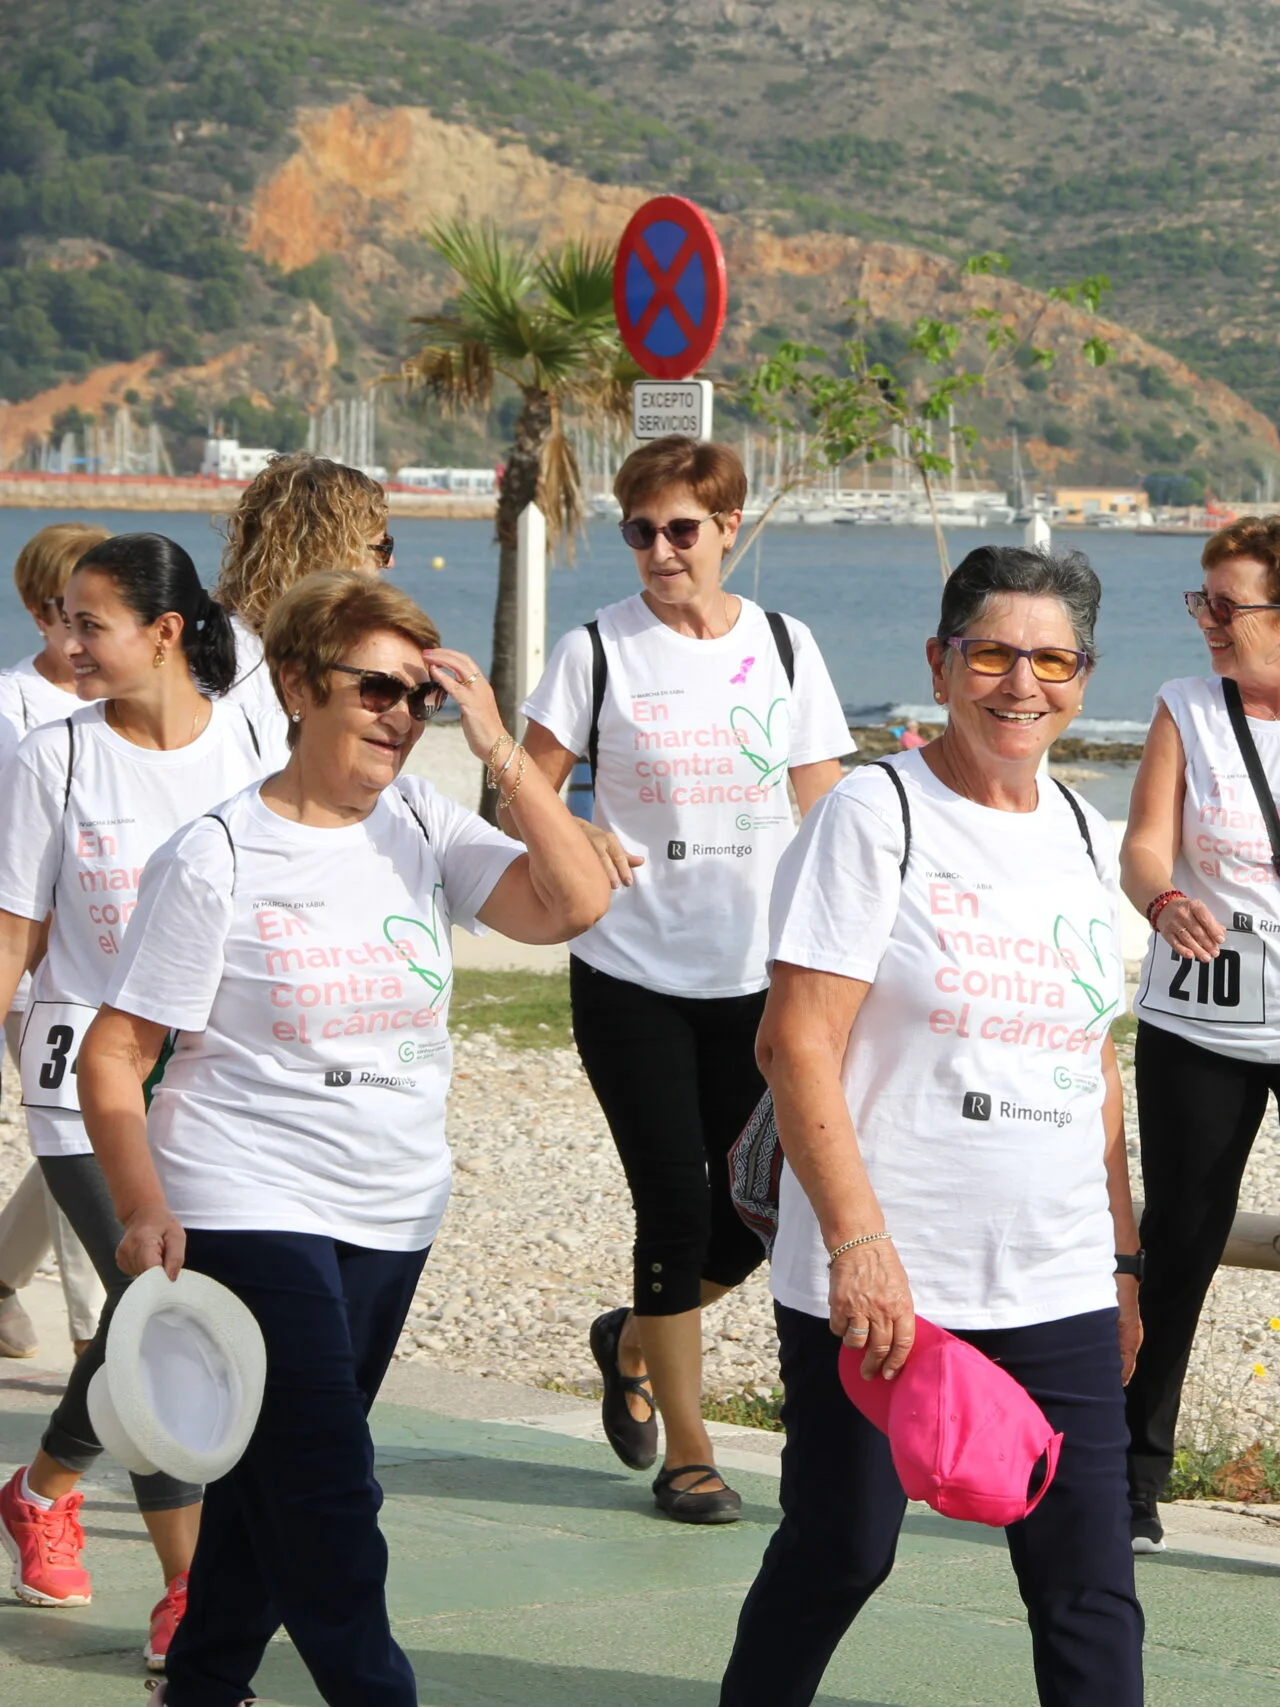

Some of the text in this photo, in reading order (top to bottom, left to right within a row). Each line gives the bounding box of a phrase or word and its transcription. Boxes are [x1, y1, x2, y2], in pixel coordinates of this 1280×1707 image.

[641, 392, 694, 408] EXCEPTO
[638, 415, 697, 432] SERVICIOS
[632, 701, 669, 722] En
[634, 724, 750, 750] marcha
[635, 753, 735, 777] contra
[639, 781, 771, 805] el cáncer
[76, 830, 118, 858] En
[1199, 858, 1221, 879] el
[929, 883, 979, 918] En
[256, 910, 308, 941] En
[98, 930, 119, 955] el
[265, 939, 418, 976] marcha
[937, 927, 1080, 971] marcha
[270, 974, 404, 1009] contra
[935, 966, 1066, 1009] contra
[1168, 948, 1241, 1007] 210
[272, 1004, 444, 1044] el cáncer
[928, 1002, 1102, 1054] el cáncer
[39, 1024, 78, 1089] 3
